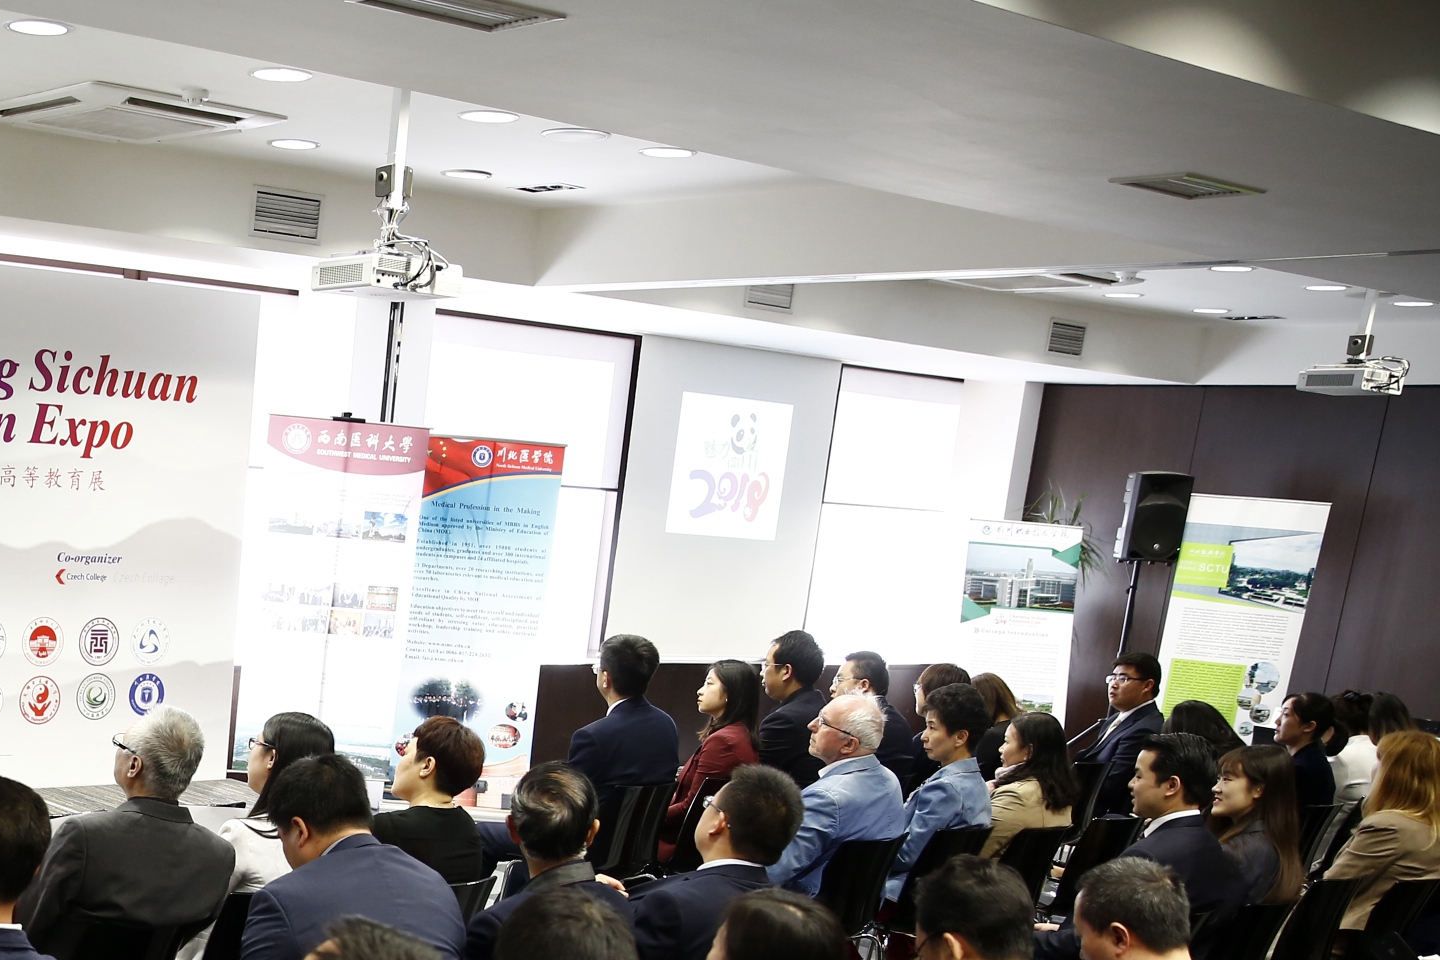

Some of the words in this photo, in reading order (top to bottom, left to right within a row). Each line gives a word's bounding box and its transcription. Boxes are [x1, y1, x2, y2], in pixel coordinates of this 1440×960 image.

[28, 348, 198, 403] Sichuan
[27, 403, 133, 459] Expo
[316, 448, 351, 458] SOUTHWEST
[353, 452, 377, 460] MEDICAL
[379, 454, 411, 464] UNIVERSITY
[431, 501, 456, 509] Medical
[459, 503, 490, 512] Profession
[517, 507, 541, 516] Making
[57, 552, 122, 565] Co-organizer
[1198, 563, 1230, 574] SCTU
[66, 573, 85, 581] Czech
[86, 573, 107, 582] College
